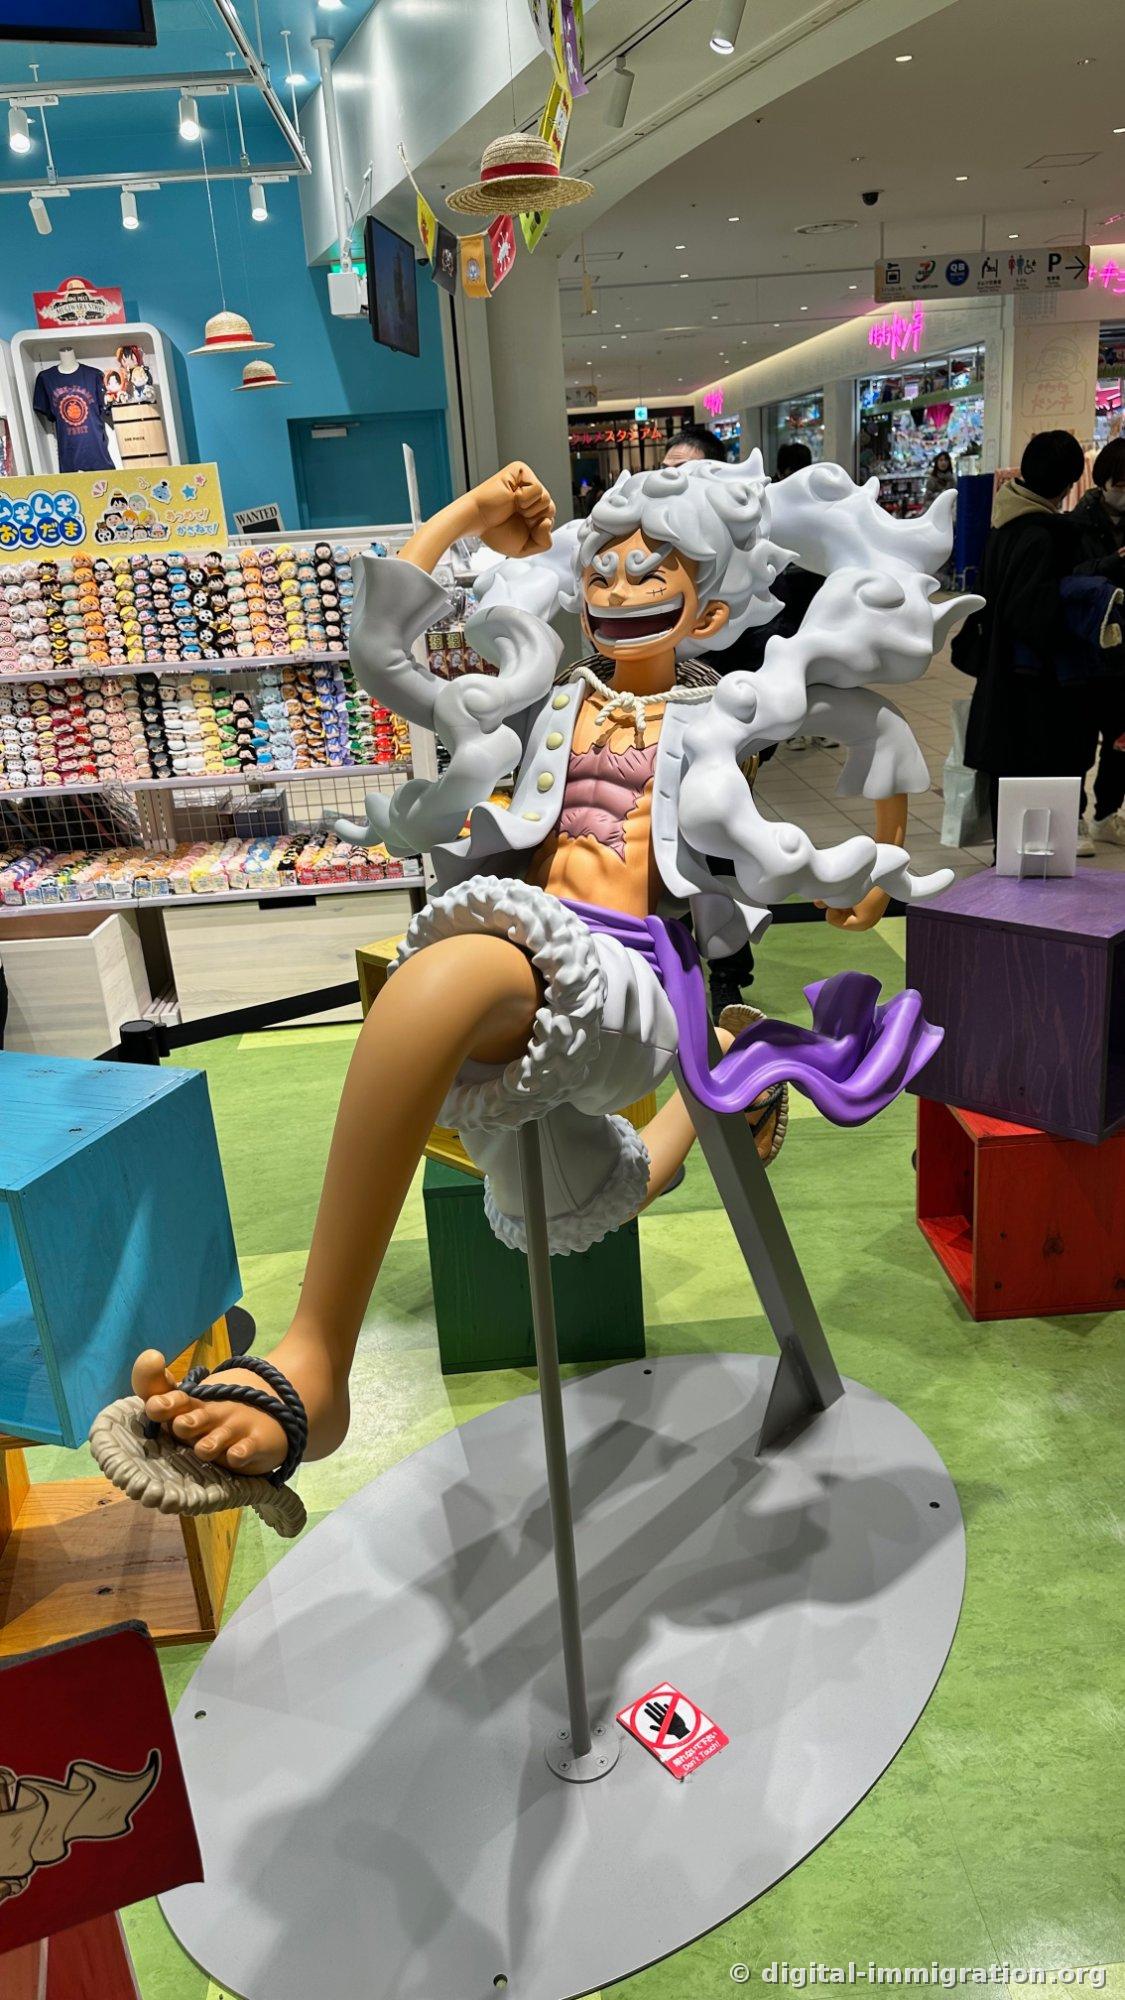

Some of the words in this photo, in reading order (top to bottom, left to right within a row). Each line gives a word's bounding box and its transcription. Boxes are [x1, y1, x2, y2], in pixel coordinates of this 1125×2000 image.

[950, 263, 966, 272] QB
[1048, 253, 1061, 272] P
[235, 506, 278, 525] WANTED
[0, 521, 78, 543] おてだま
